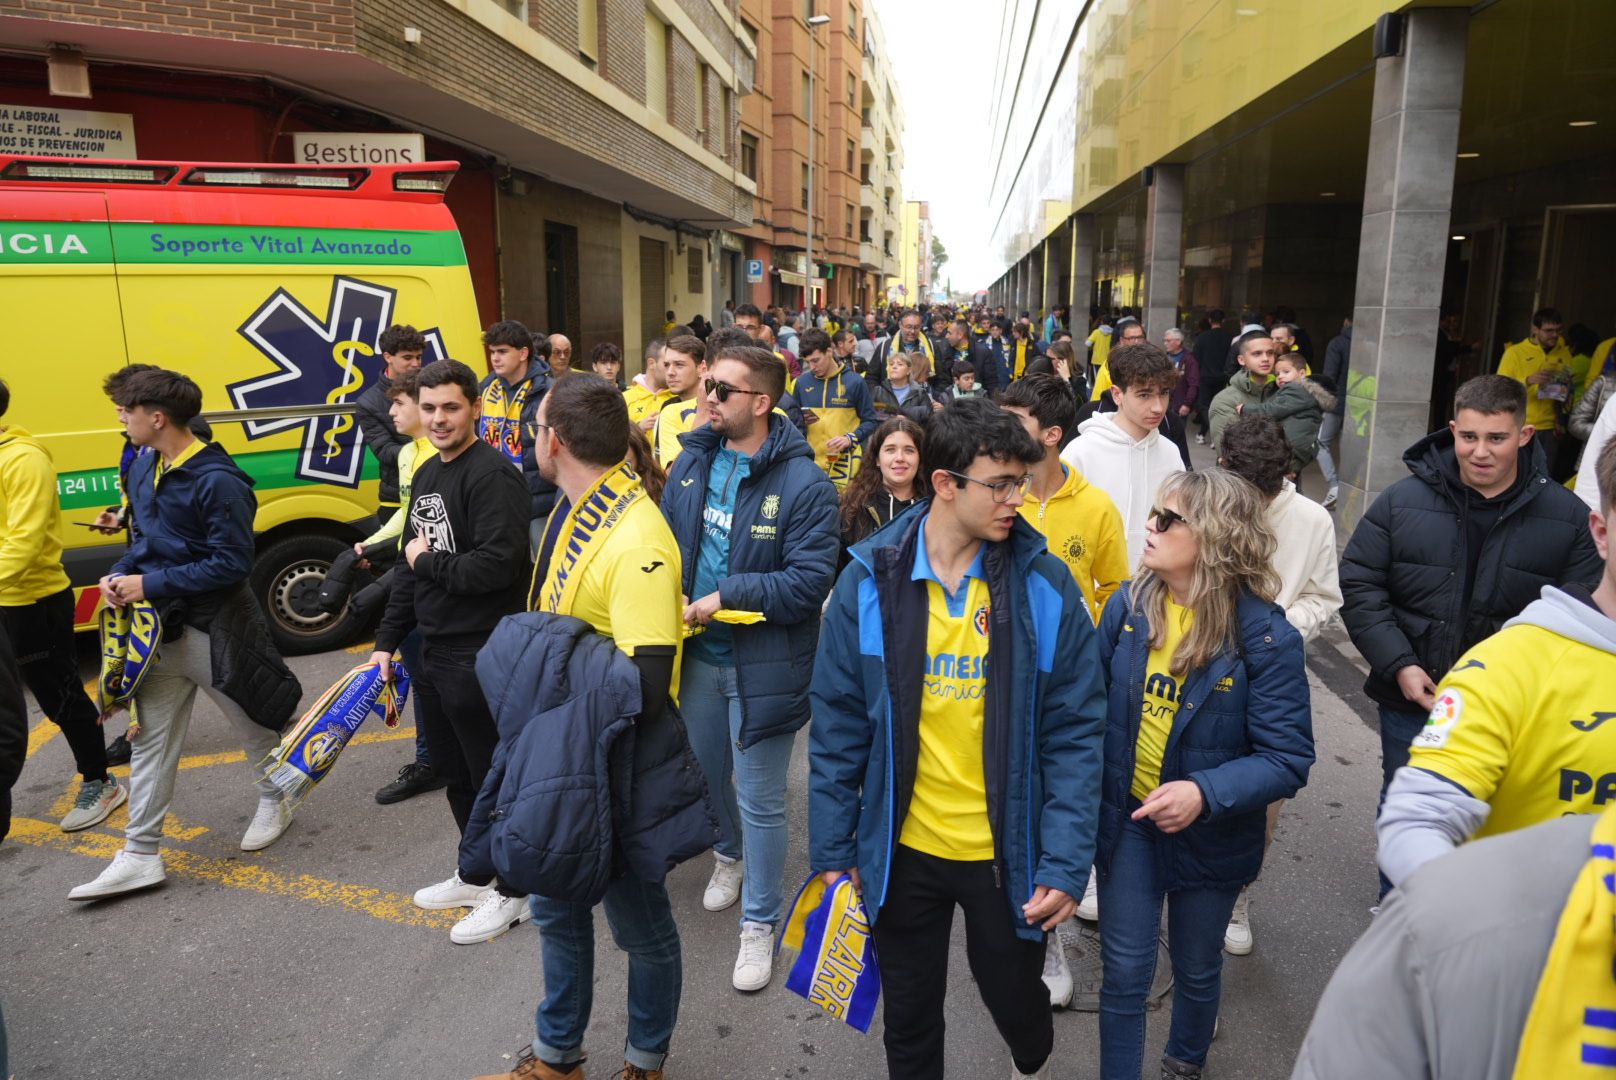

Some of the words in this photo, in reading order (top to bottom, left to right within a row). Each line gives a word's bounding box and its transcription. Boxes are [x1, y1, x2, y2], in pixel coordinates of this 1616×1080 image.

[13, 109, 60, 123] LABORAL
[0, 123, 14, 133] LE
[27, 124, 62, 136] FISCAL
[74, 127, 122, 141] JURIDICA
[20, 137, 34, 147] DE
[38, 138, 105, 152] PREVENCION
[303, 142, 412, 164] gestions
[150, 233, 244, 257] Soporte
[250, 235, 304, 254] Vital
[311, 237, 412, 256] Avanzado
[749, 261, 760, 275] P
